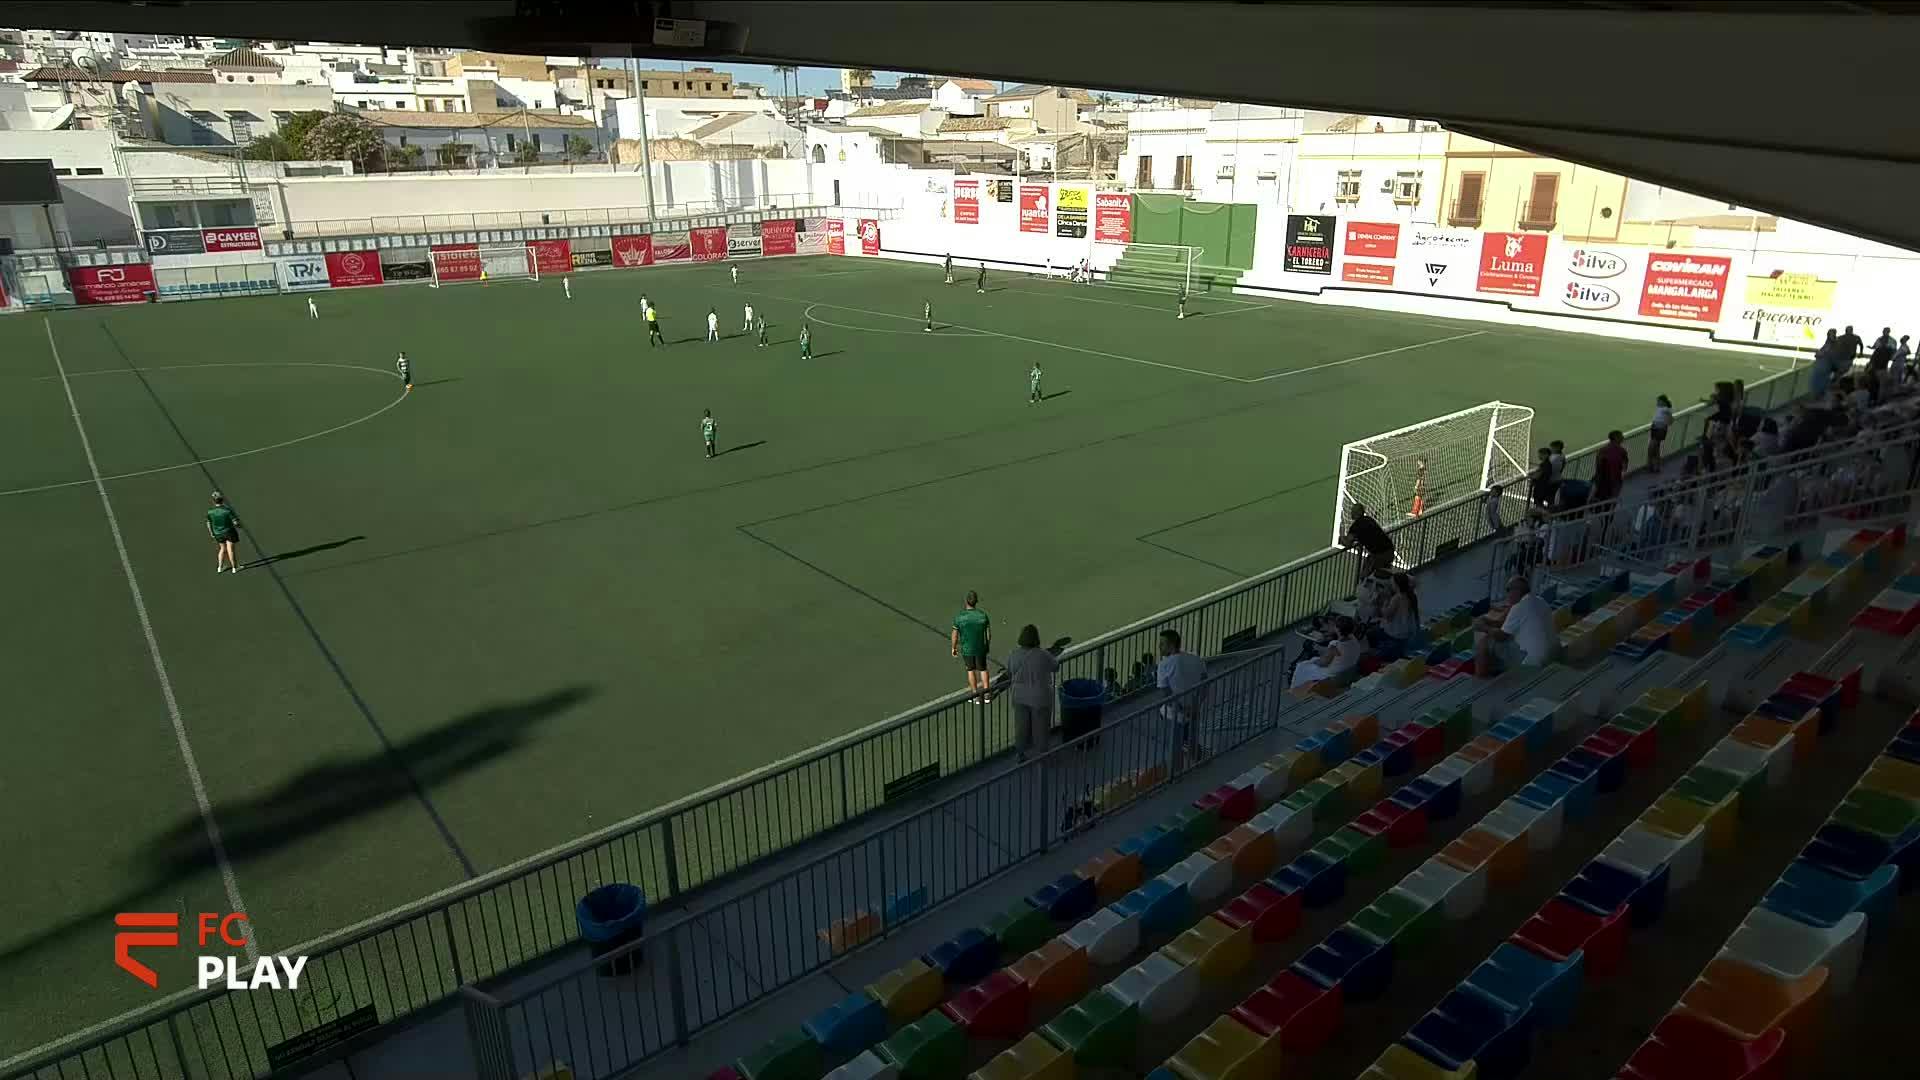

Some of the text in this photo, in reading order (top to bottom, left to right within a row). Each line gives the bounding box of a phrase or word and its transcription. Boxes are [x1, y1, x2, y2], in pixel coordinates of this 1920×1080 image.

[217, 232, 258, 242] CAYSER
[1292, 256, 1324, 267] EL TORERO
[1490, 256, 1534, 273] Luma
[1572, 249, 1617, 270] Silva
[1656, 277, 1714, 288] SUPERMERCADO
[1565, 281, 1610, 303] Silva
[1647, 284, 1719, 301] MANGALARGA
